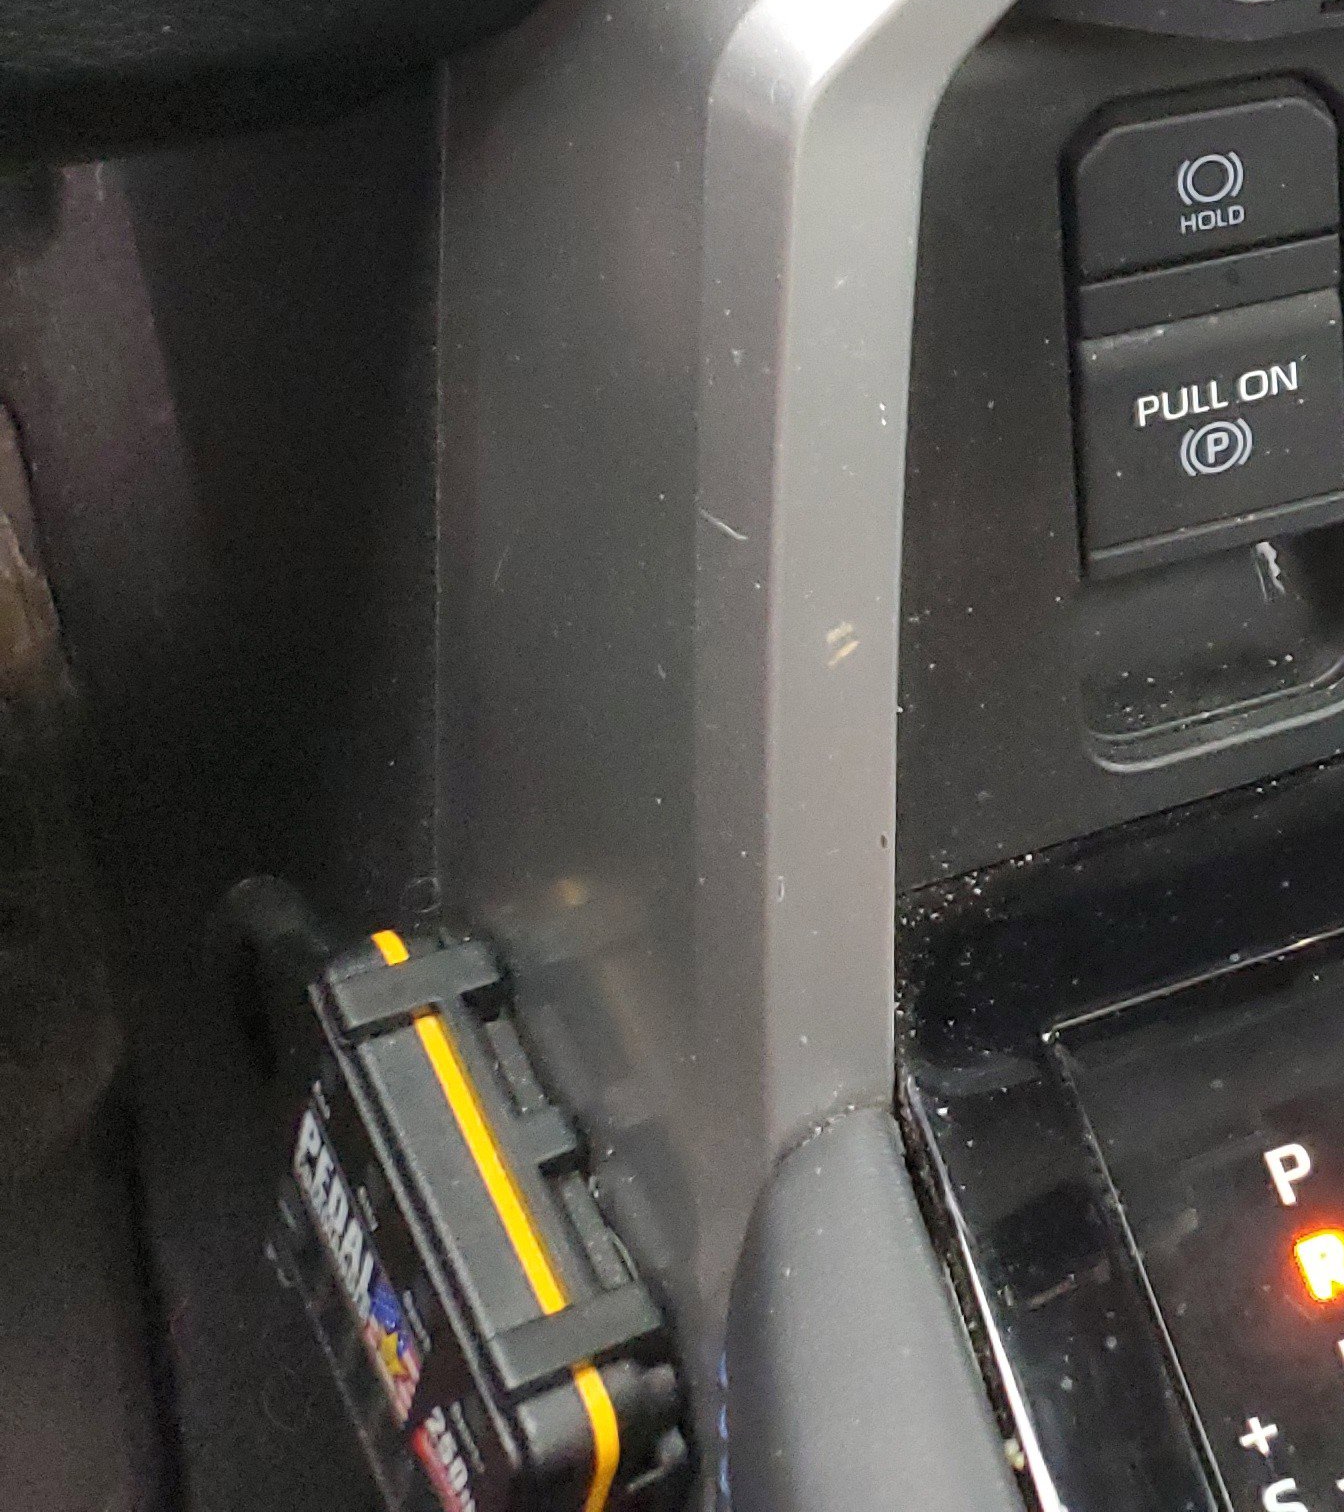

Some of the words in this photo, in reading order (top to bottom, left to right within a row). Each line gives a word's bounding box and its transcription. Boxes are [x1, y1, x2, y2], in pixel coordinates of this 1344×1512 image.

[1180, 204, 1245, 234] HOLD
[1135, 381, 1229, 428] PULL
[1239, 360, 1299, 403] ON
[1206, 432, 1231, 464] P
[1263, 1143, 1311, 1206] P
[1261, 1478, 1306, 1512] S
